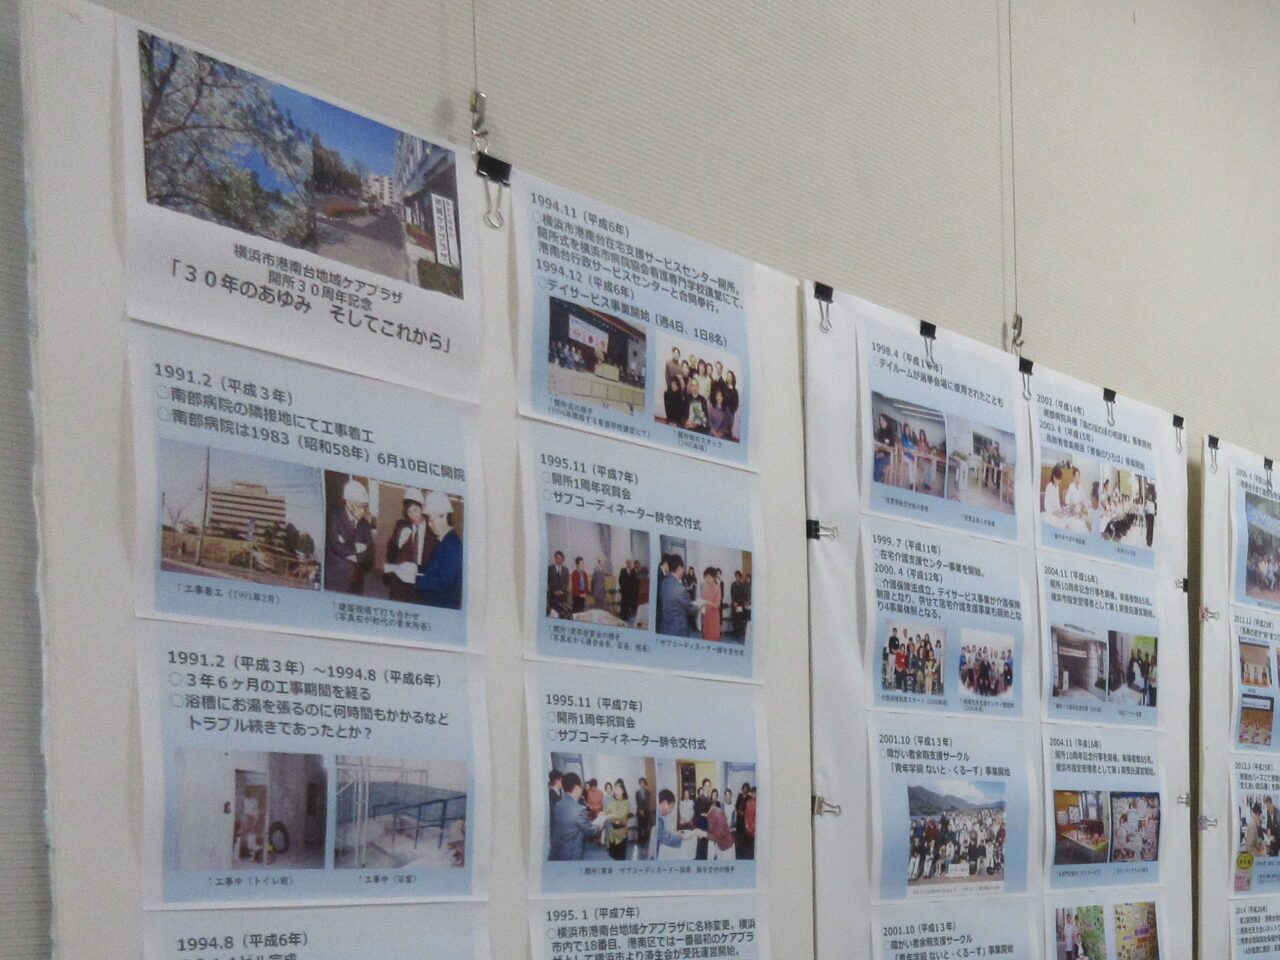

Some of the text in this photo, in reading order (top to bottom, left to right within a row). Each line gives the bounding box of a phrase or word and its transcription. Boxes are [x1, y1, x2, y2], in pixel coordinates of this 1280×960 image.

[530, 191, 630, 240] 1994.11（平成6年）
[542, 212, 740, 296] 横浜市港南台在宅支援サービスセンター開所。
[233, 243, 403, 306] 横浜市港南台地域ケアプラザ
[267, 269, 373, 313] 開所30周年記念
[535, 256, 635, 301] 1994.12（平成6年）
[170, 259, 451, 354] 「30年のあゆみ そしてこれから」
[153, 361, 294, 407] 1991.2（平成3年）
[879, 357, 1004, 408] デイルームが選挙会場に使用されたことも
[170, 386, 375, 445] 南部病院の隣接地にて工事着工
[171, 407, 466, 483] 南部病院は1983（昭和58年）6月10日に開院
[540, 452, 639, 486] 1995.11（平成7年）
[551, 471, 632, 501] 開所1周年祝賀会
[552, 489, 702, 532] サブコーディネーター辞令交付式
[879, 549, 984, 577] 在宅介護支援センター事業を開始。
[882, 578, 1020, 609] 介護保険法成立。デイサービス事業が介護保険
[185, 693, 449, 726] 浴槽にお湯を張るのに何時間もかかるなど
[545, 693, 643, 712] 1995.11（平成7年）
[189, 714, 372, 740] トラブル続きであったとか？
[556, 711, 636, 729] 開所1周年祝賀会
[558, 728, 707, 750] サブコーディネーター辞令交付式
[176, 931, 308, 952] 1994.8（平成6年）
[551, 931, 754, 953] 市内で18番目、港南区では一番最初のケアプラ
[556, 918, 756, 938] 横浜市港南台地域ケアプラザに名称変更。横浜
